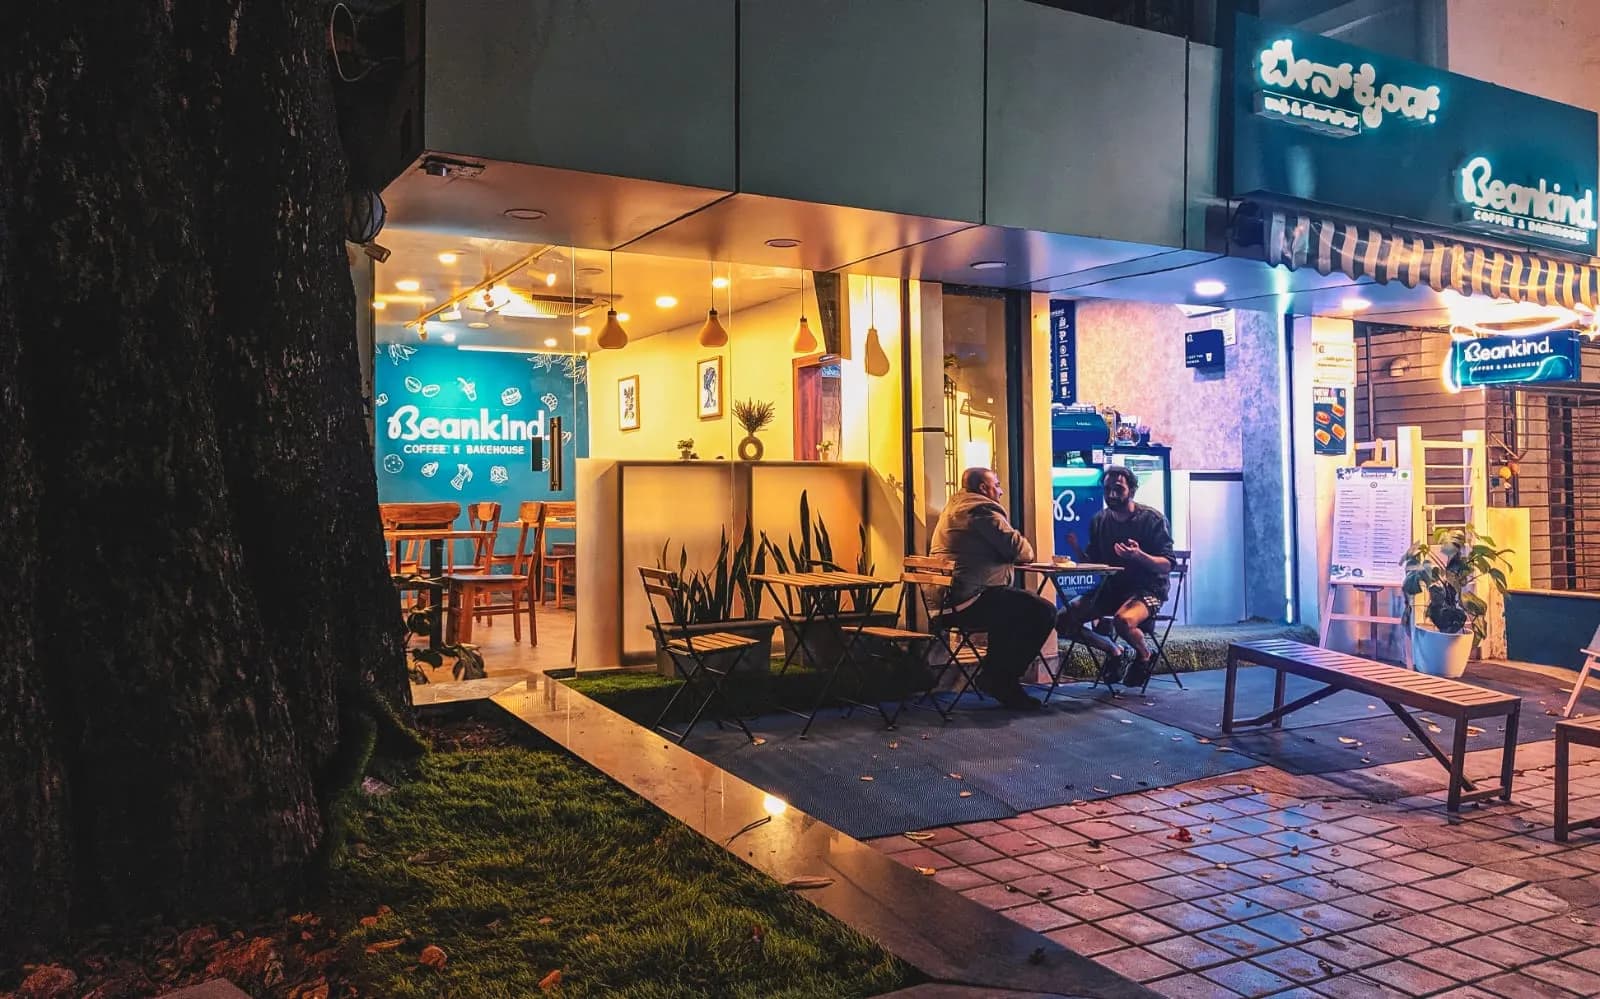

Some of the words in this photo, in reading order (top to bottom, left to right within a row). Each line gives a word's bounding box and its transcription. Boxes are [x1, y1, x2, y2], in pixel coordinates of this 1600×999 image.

[1462, 157, 1597, 229] Beankind.
[1473, 210, 1514, 227] COFFEE
[1464, 336, 1553, 362] Beankind.
[403, 444, 447, 454] COFFEE
[466, 445, 525, 455] BAKEHOUSE
